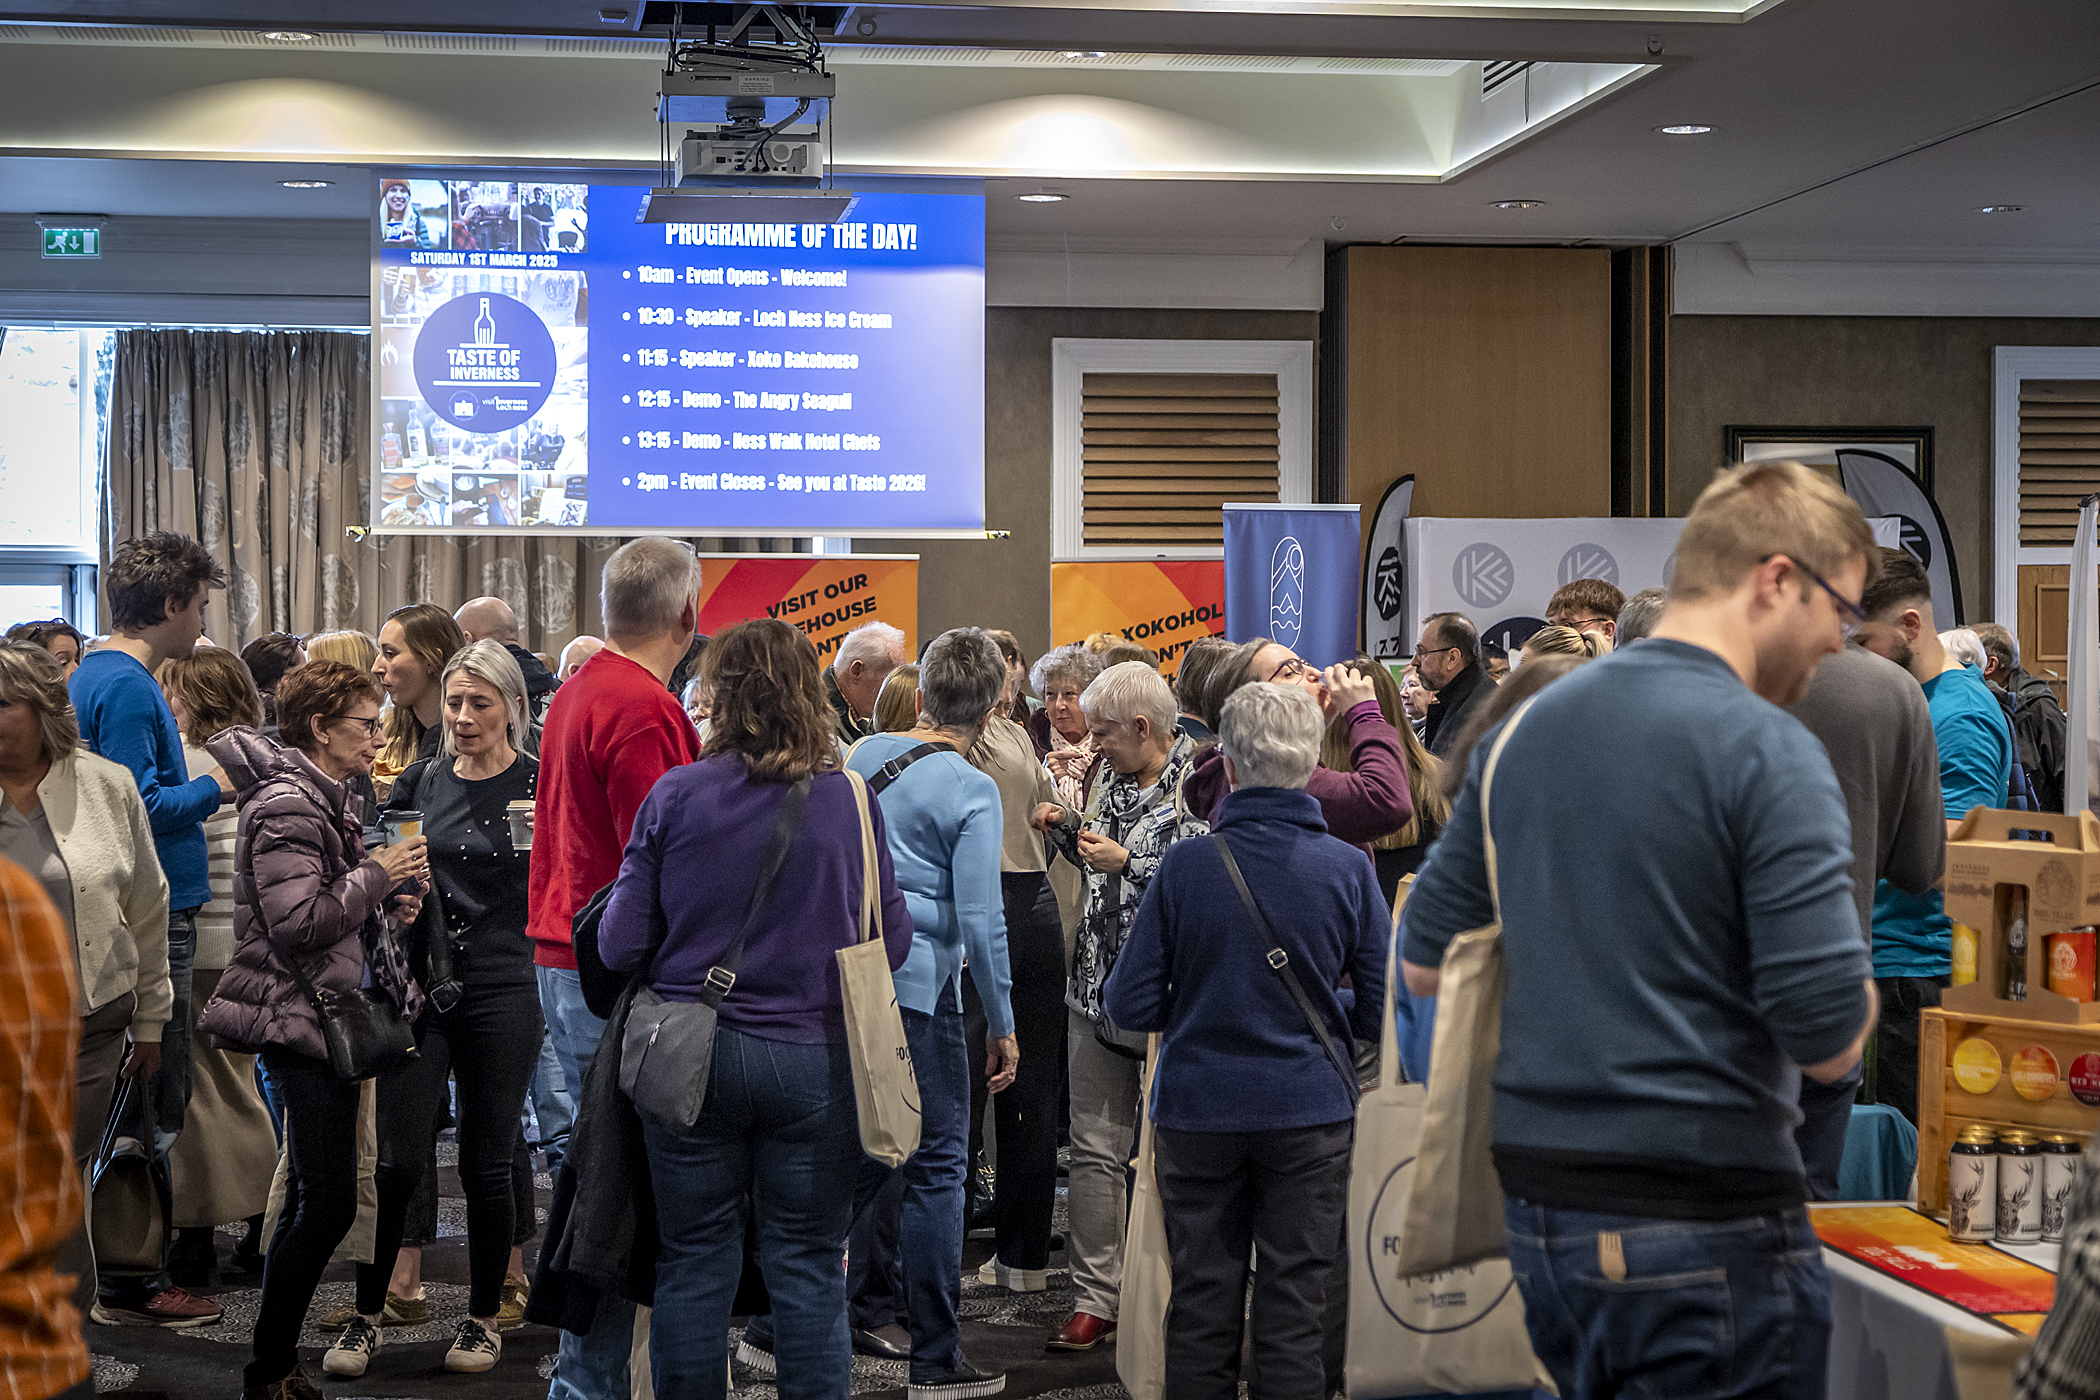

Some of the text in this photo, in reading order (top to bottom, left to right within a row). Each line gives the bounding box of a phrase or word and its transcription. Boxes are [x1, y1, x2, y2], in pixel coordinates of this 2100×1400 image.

[665, 222, 918, 250] PROGRAMME OF THE DAY!
[410, 251, 559, 268] SATURDAY 1ST MARCH 2025
[637, 265, 675, 284] 10am
[686, 267, 724, 285] Event
[726, 268, 769, 288] Opens
[780, 269, 848, 287] Welcome!
[637, 307, 674, 325] 10:30
[685, 308, 742, 328] Speaker
[753, 310, 786, 327] Loch
[788, 310, 823, 328] Ness
[825, 311, 847, 328] Ice
[848, 311, 893, 329] Cream
[446, 348, 521, 366] TASTE OF
[637, 348, 669, 367] 11:15
[679, 349, 737, 369] Speaker
[747, 350, 782, 368] Xoko
[784, 351, 859, 369] Bakehouse
[450, 366, 520, 380] INVERNESS
[637, 390, 671, 408] 12:15
[682, 390, 722, 408] Demo
[732, 391, 758, 409] The
[760, 392, 800, 412] Angry
[802, 392, 852, 411] Seagull
[637, 430, 671, 449] 13:15
[682, 431, 722, 449] Demo
[732, 432, 767, 450] Ness
[769, 432, 803, 450] Walk
[805, 433, 841, 451] Hotel
[842, 433, 881, 451] Chefs
[637, 472, 669, 492] 2pm
[680, 472, 718, 490] Event
[720, 473, 767, 491] Closes
[777, 473, 803, 491] See
[804, 475, 831, 493] you
[833, 474, 848, 491] at
[849, 474, 887, 492] Taste
[888, 474, 927, 492] 2026!
[766, 573, 868, 619] VISIT OUR
[796, 596, 877, 635] EHOUSE
[1121, 603, 1225, 641] XOKOHOL
